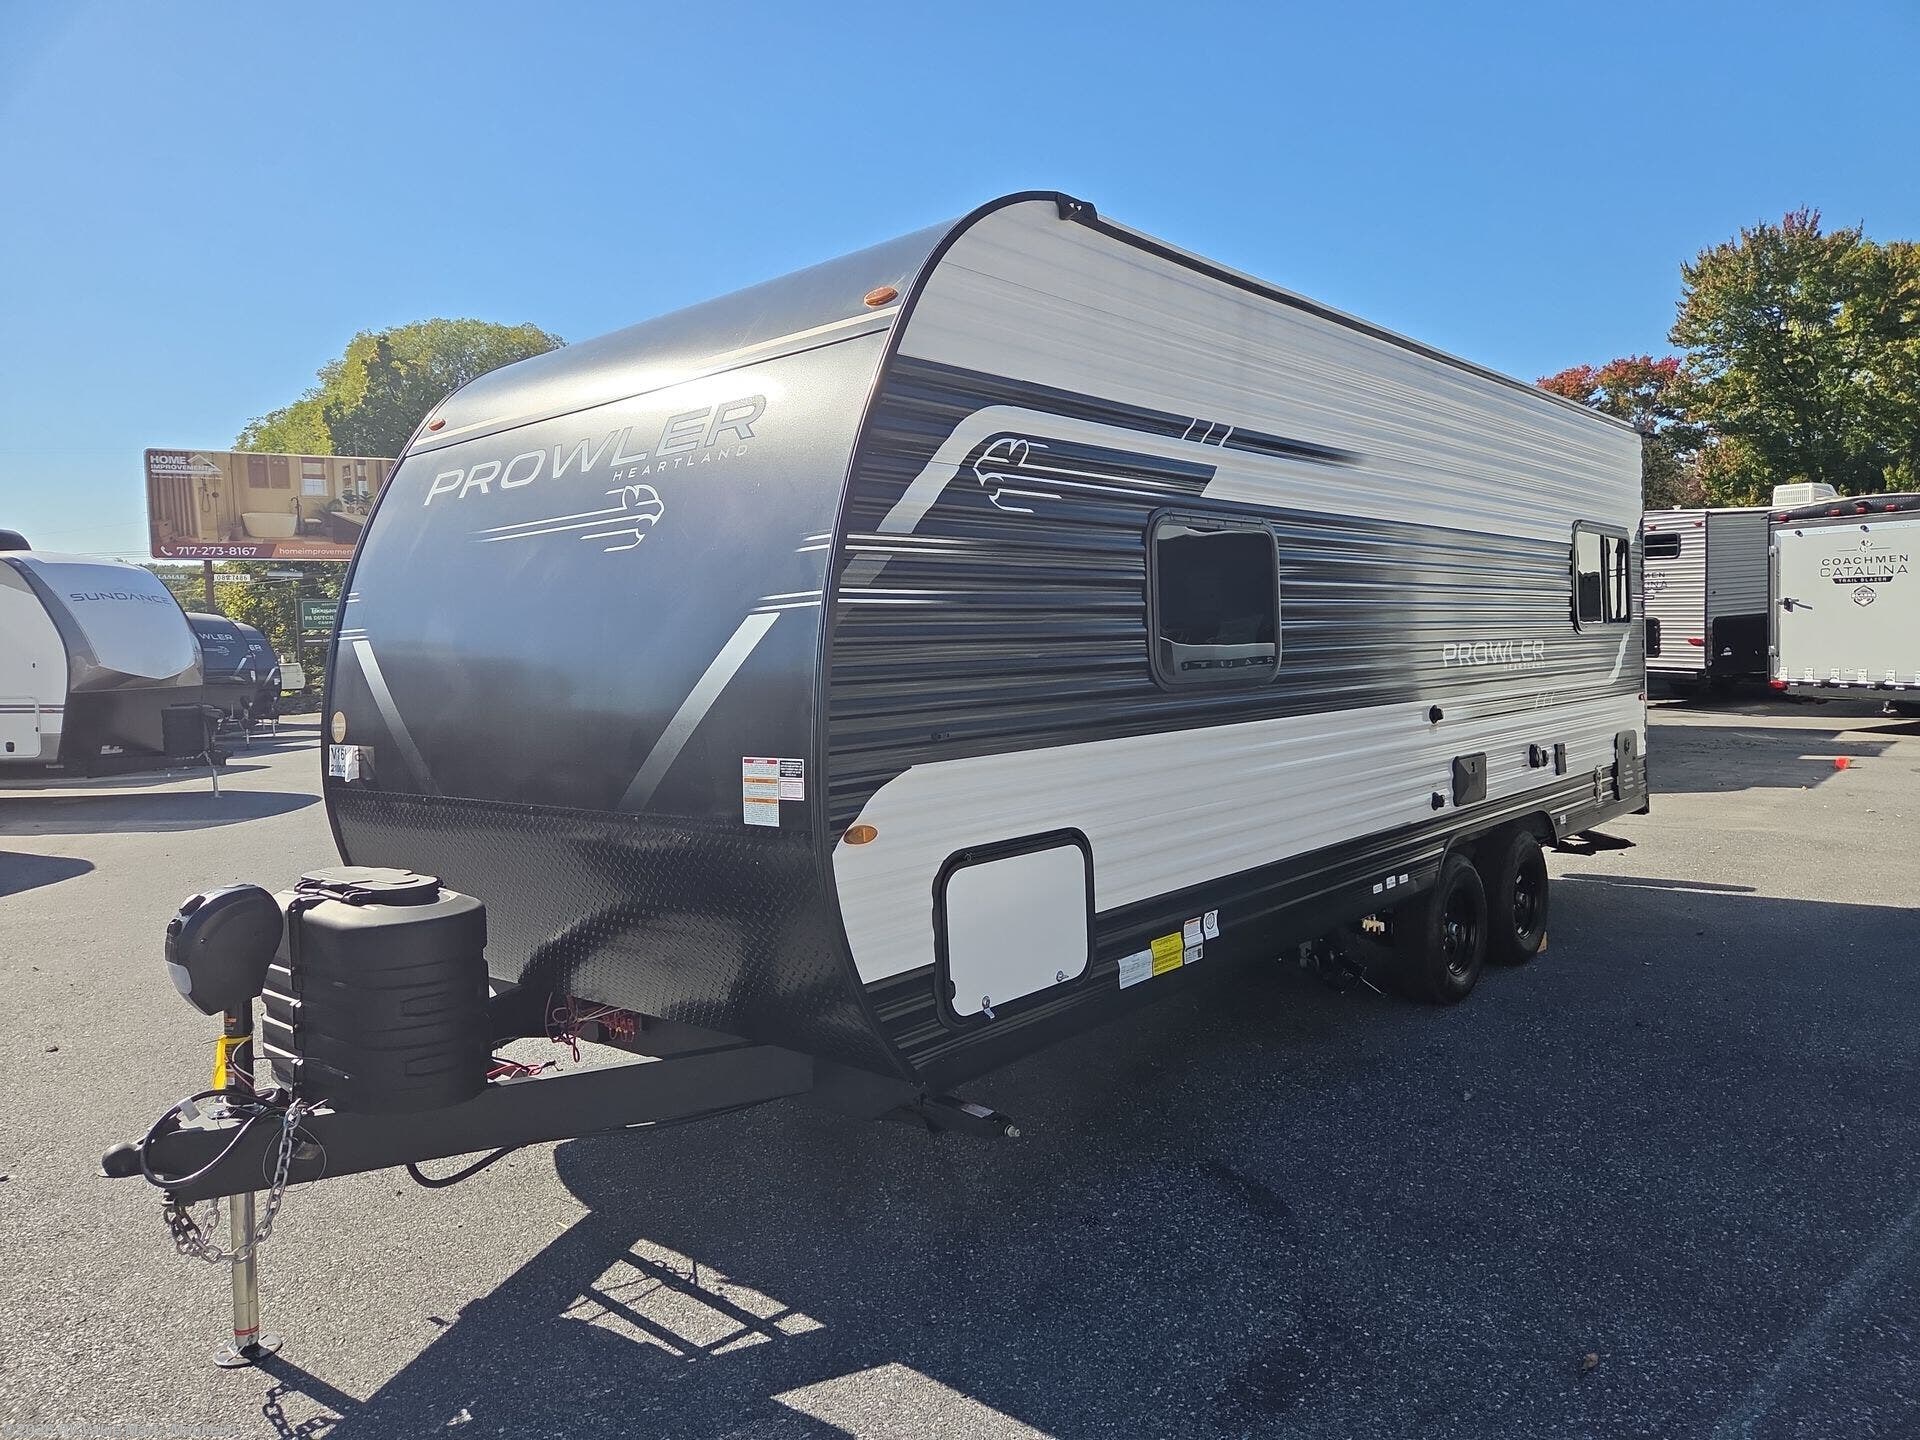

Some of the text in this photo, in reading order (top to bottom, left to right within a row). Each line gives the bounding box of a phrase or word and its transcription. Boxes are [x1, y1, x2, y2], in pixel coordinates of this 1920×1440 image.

[423, 394, 767, 506] PROWLER
[149, 455, 187, 464] HOME
[612, 444, 749, 482] HEARTLAND
[176, 546, 257, 556] 717-273-8167
[1821, 554, 1909, 566] COACHMEN
[1820, 564, 1909, 578] CATALINA
[69, 592, 172, 606] SUNDANCE
[1442, 640, 1545, 668] PROWLER
